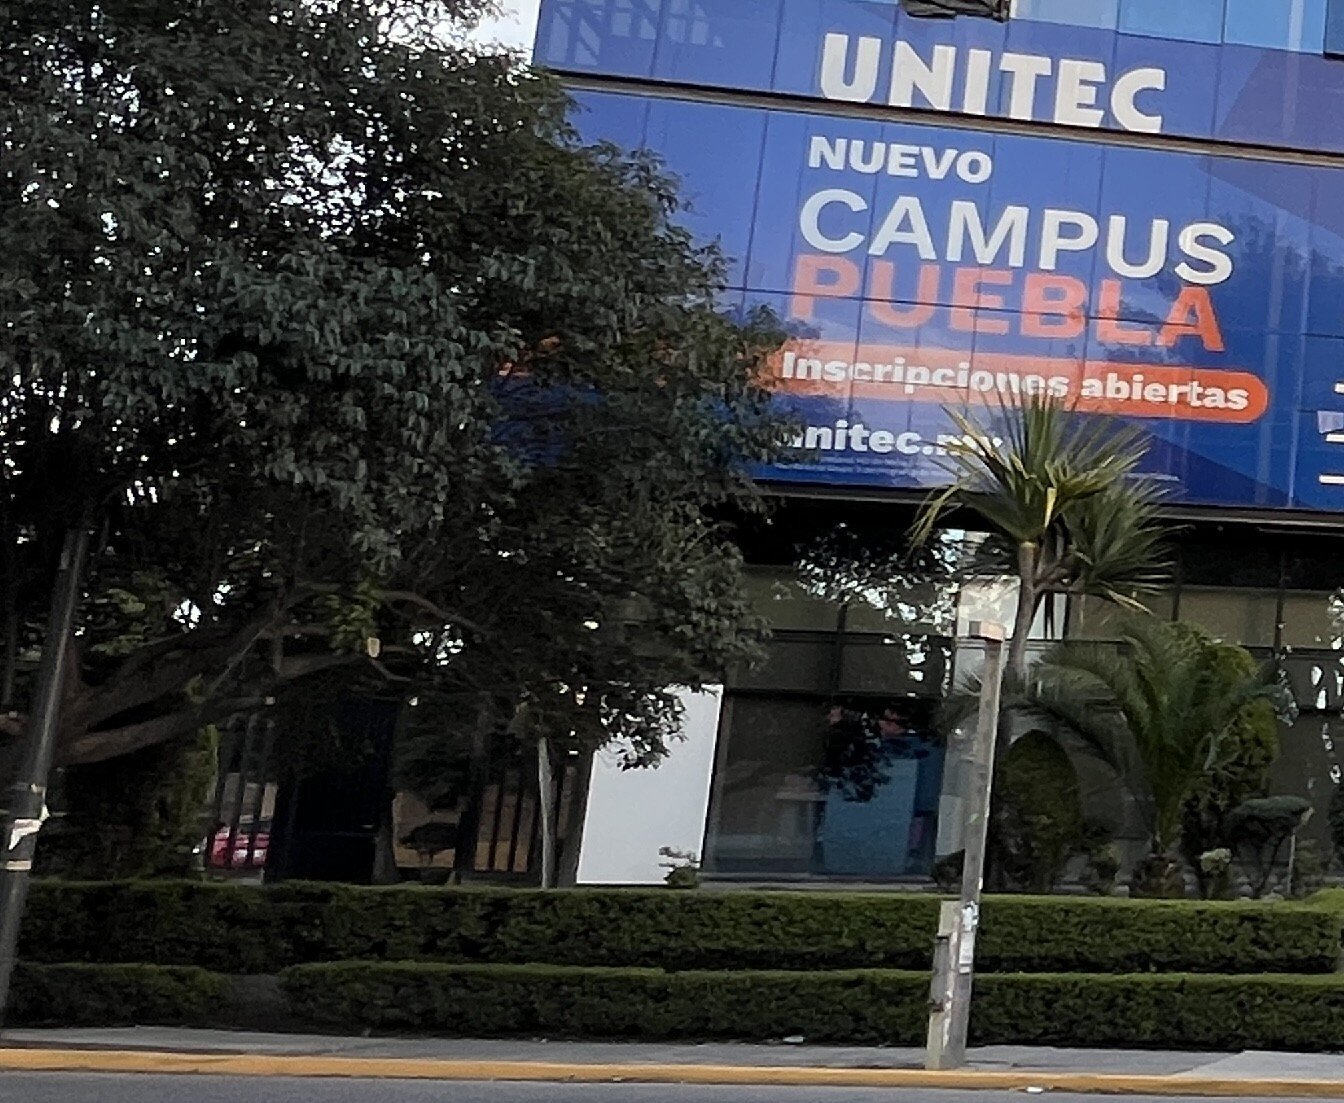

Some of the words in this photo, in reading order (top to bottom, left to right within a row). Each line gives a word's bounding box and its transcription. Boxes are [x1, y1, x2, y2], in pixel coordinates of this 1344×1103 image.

[819, 33, 1166, 132] UNITEC
[808, 136, 992, 184] NUEVO
[800, 189, 1235, 285] CAMPUS
[791, 255, 1224, 352] PUEBLA
[781, 352, 1069, 397] Inscripciones
[1081, 373, 1250, 410] abiertas
